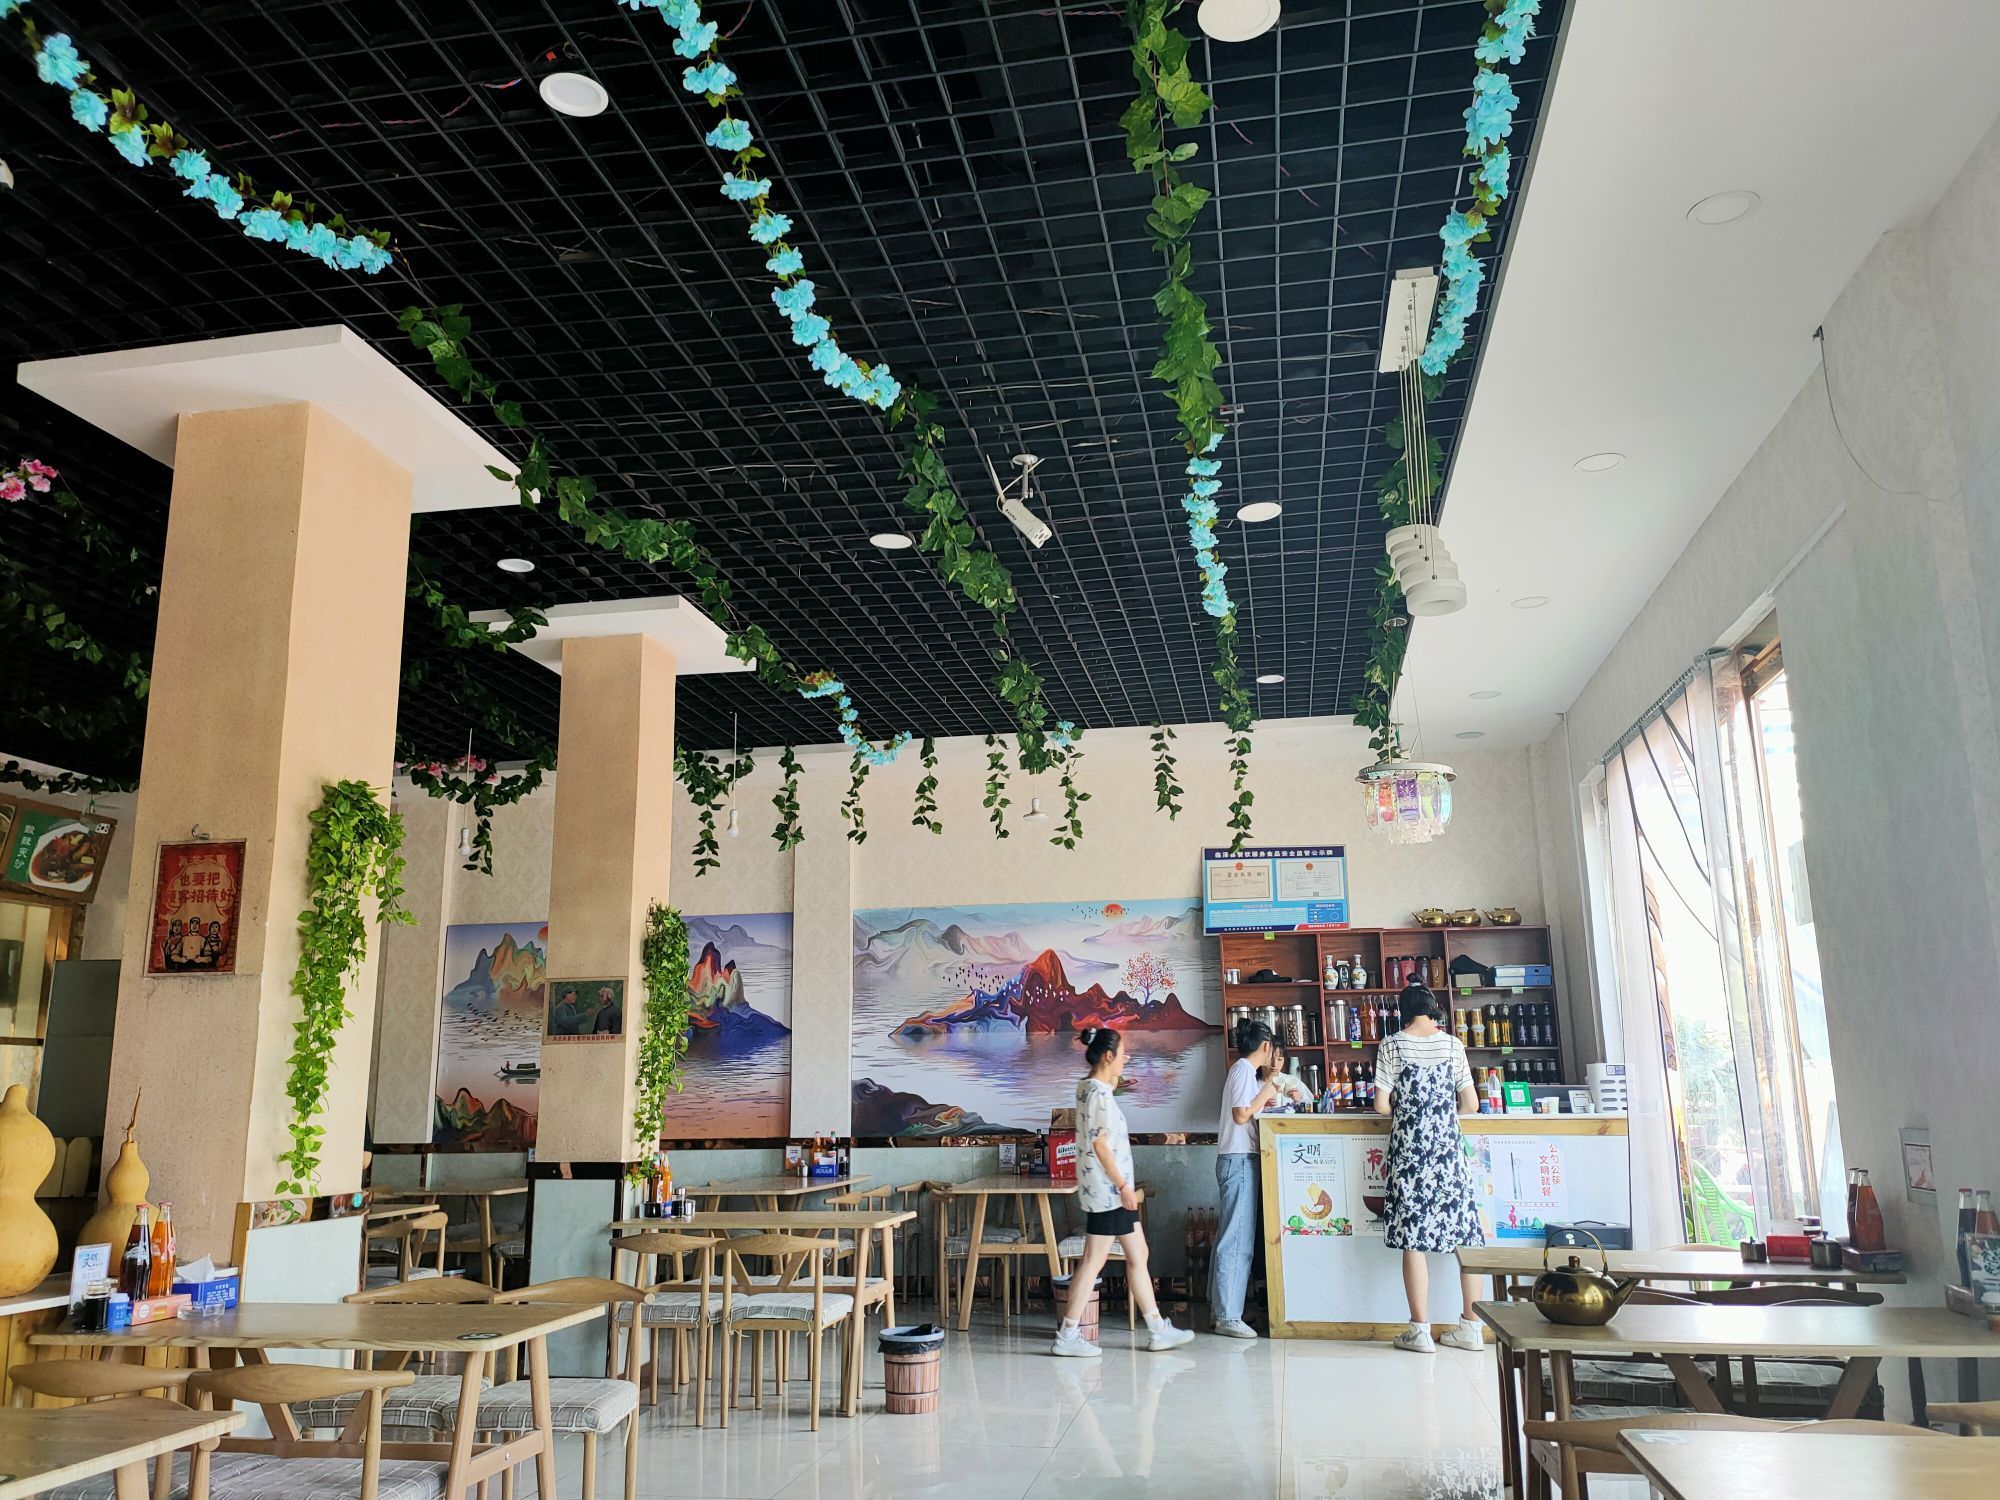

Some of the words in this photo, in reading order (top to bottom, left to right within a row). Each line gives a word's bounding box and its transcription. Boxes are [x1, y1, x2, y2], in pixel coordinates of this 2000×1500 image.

[180, 872, 221, 887] 也要把
[1291, 1143, 1321, 1165] 文明
[1549, 1143, 1561, 1185] 公勺公筷
[1539, 1155, 1552, 1197] 文明就餐
